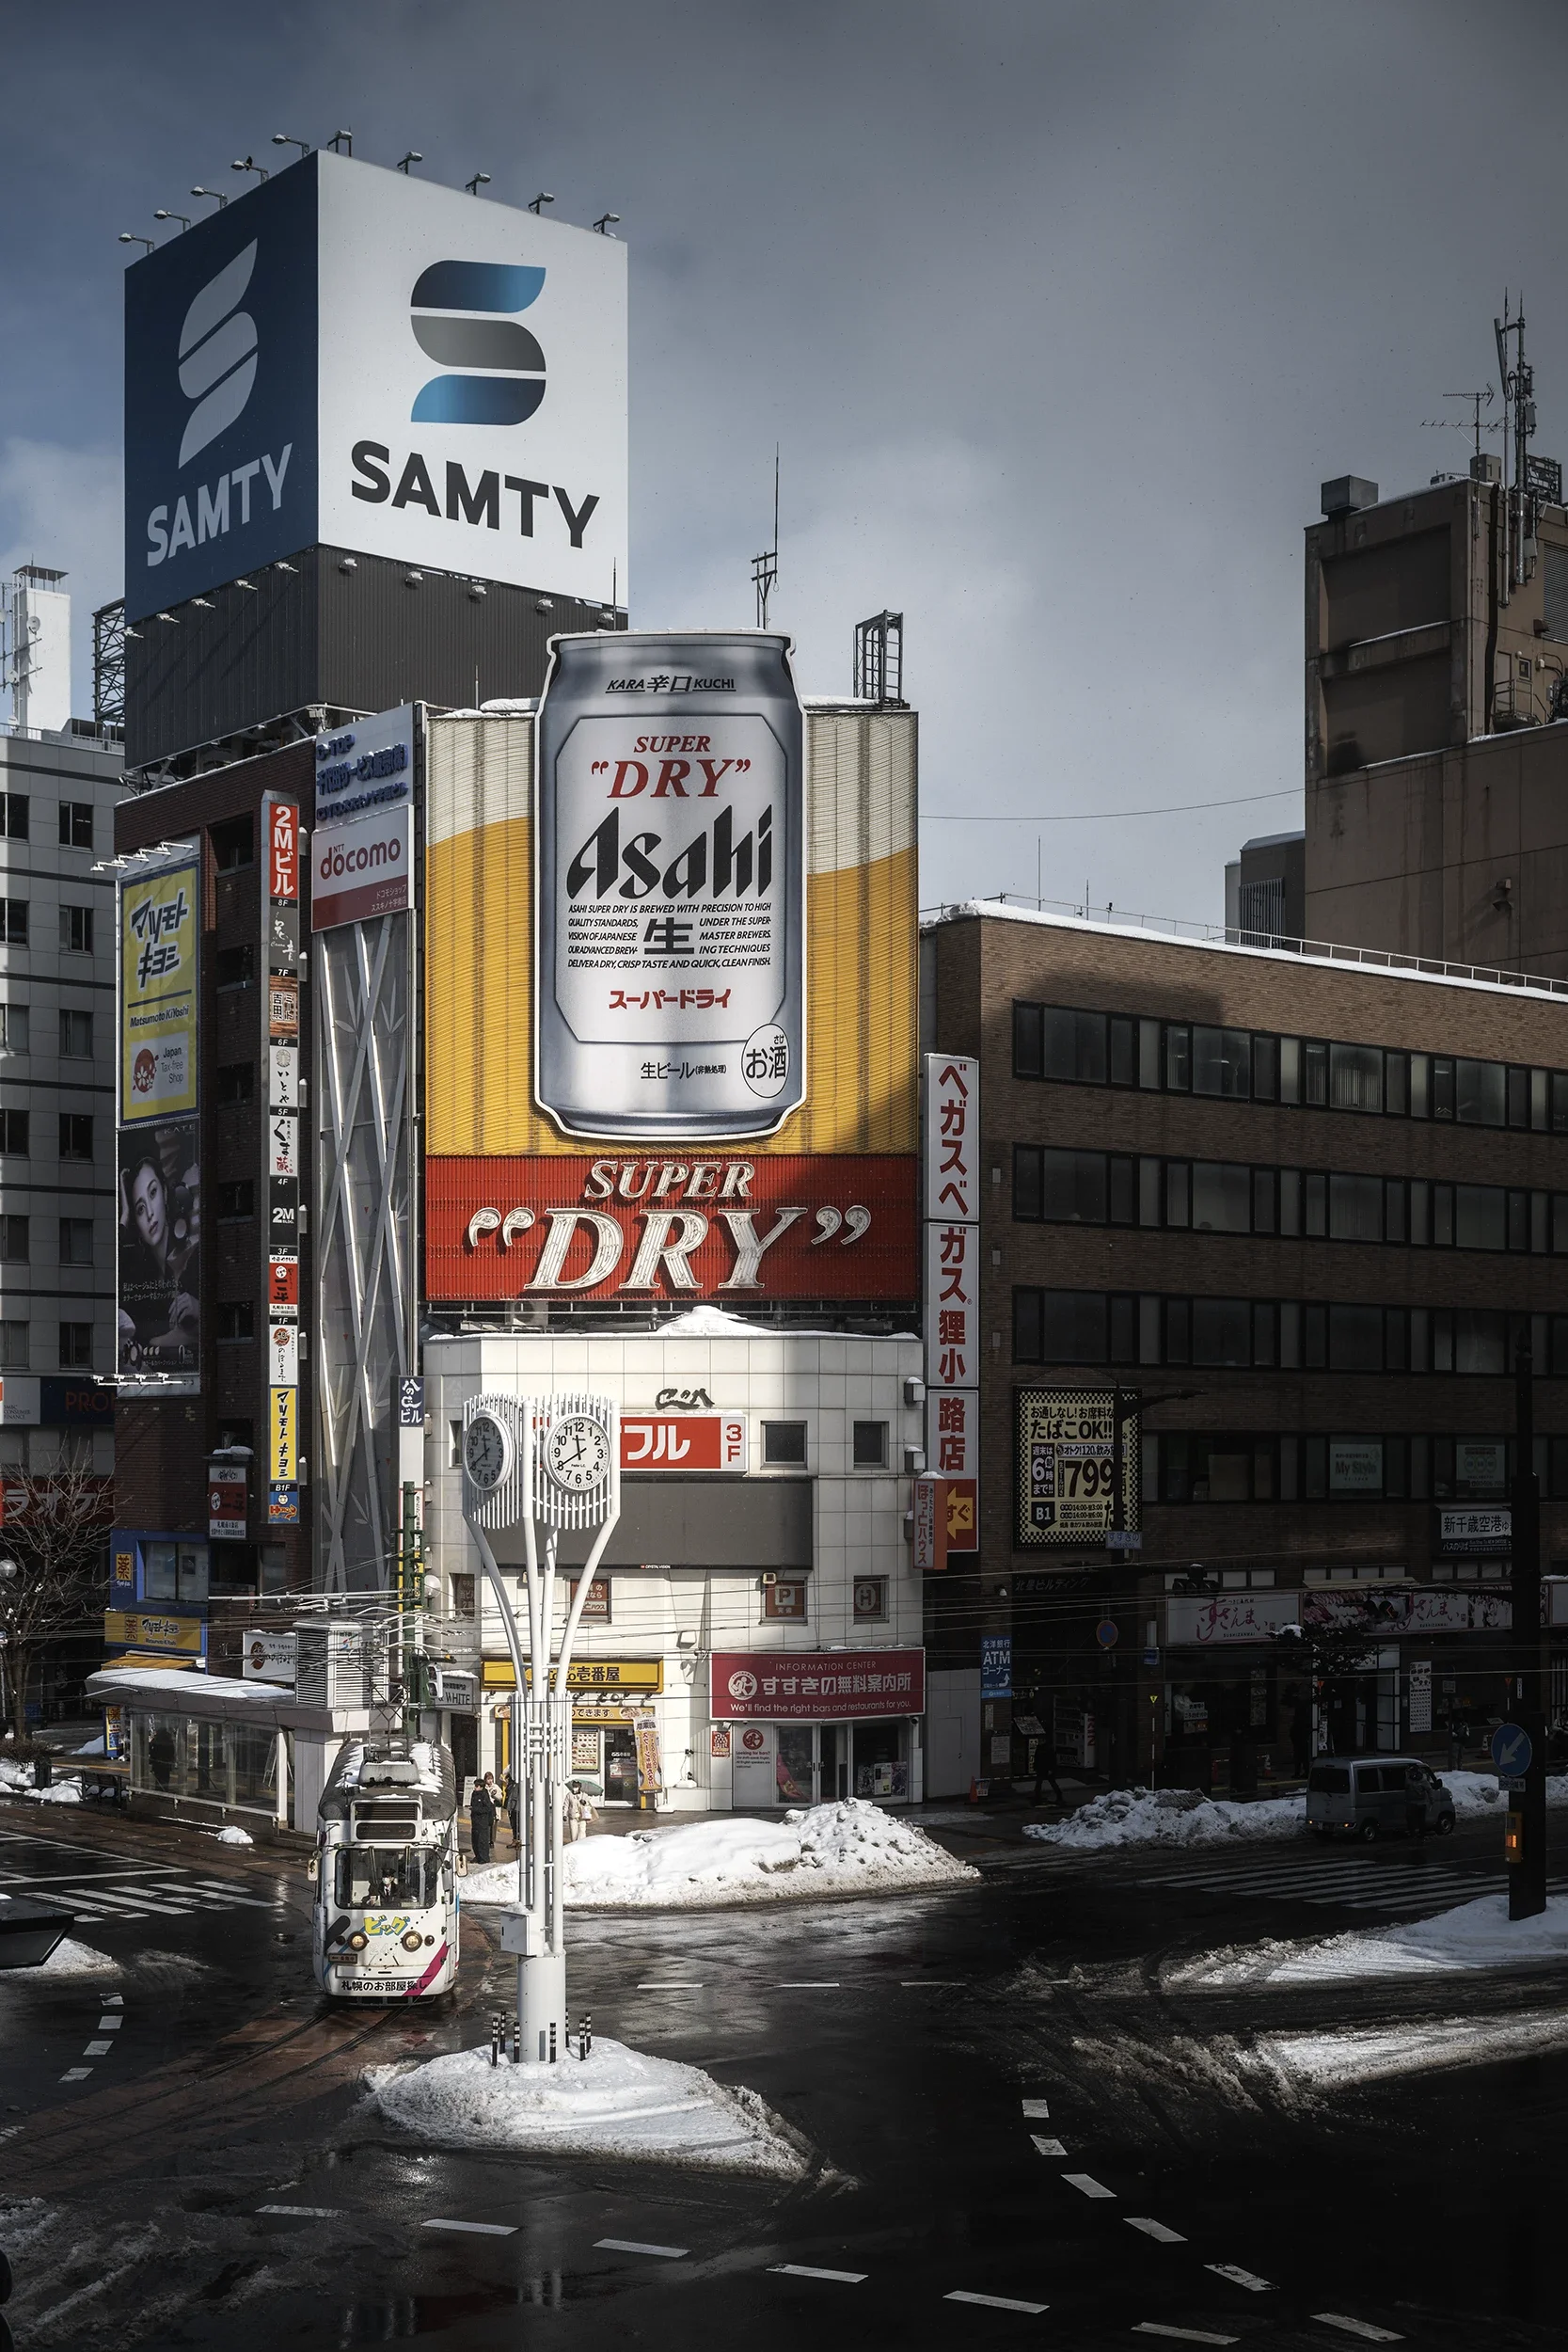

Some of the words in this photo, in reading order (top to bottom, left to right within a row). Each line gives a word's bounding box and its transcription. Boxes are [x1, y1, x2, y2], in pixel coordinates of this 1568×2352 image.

[351, 440, 600, 548] SAMTY
[147, 442, 293, 566] SAMTY
[608, 679, 644, 690] KARA
[647, 675, 692, 692] 辛口
[693, 678, 735, 690] KUCHI
[634, 736, 711, 753] SUPER
[274, 805, 294, 896] 2Mビル
[333, 843, 344, 853] NTT
[566, 804, 772, 900] Asahi
[321, 838, 401, 880] docomo
[376, 883, 407, 899] ドコモショップ
[568, 905, 587, 914] ASAHI
[588, 905, 610, 914] SUPER
[612, 905, 629, 914] DRY
[630, 905, 639, 914] IS
[639, 905, 674, 914] BREWED
[677, 904, 700, 913] WITH
[701, 903, 743, 913] PRECISION
[744, 903, 753, 912] TO
[754, 902, 771, 911] HIGH
[131, 892, 188, 943] マツモト
[568, 918, 594, 927] QUALITY
[594, 918, 639, 928] STANDARDS,
[699, 917, 730, 927] UNDER
[731, 916, 748, 926] THE
[568, 931, 589, 940] VISION
[597, 932, 638, 941] JAPANESE
[699, 930, 736, 940] MASTER
[643, 917, 694, 955] 生
[580, 946, 614, 954] ADVANCED
[699, 946, 717, 954] ING
[719, 944, 770, 953] TECHNIQUES
[137, 942, 180, 988] キヨシ
[617, 960, 641, 968] CRISP
[641, 960, 669, 968] TASTE
[669, 960, 689, 968] AND
[721, 958, 748, 967] CLEAN
[277, 968, 289, 977] 7F
[609, 988, 732, 1009] スーパードライ
[773, 1035, 784, 1044] さけ
[163, 1047, 182, 1059] Japan
[161, 1060, 183, 1073] Tax-free
[746, 1045, 787, 1080] お酒
[169, 1073, 183, 1084] Shop
[165, 1123, 195, 1135] KATE
[585, 1160, 755, 1199] SUPER
[401, 1409, 422, 1423] ビル
[277, 1391, 290, 1478] マツモトキヨシ
[1030, 1420, 1112, 1439] たばこOK!!
[726, 1423, 742, 1462] 3F
[1033, 1457, 1045, 1481] 6
[276, 1484, 291, 1492] B1F
[1036, 1507, 1051, 1520] B1
[1109, 1532, 1139, 1541] すすきの
[118, 1555, 130, 1579] 薬
[779, 1588, 791, 1603] P
[983, 1639, 1010, 1648] 北洋銀行
[983, 1651, 1010, 1664] ATM
[775, 1662, 844, 1672] INFORMATION
[847, 1661, 876, 1670] CENTER
[983, 1666, 1010, 1676] コーナー
[761, 1672, 911, 1695] すすきの無料案内所
[446, 1692, 470, 1705] WHITE
[730, 1704, 752, 1712] We'll
[753, 1704, 771, 1712] find
[773, 1704, 788, 1712] the
[790, 1704, 811, 1715] right
[813, 1704, 832, 1712] bars
[832, 1702, 847, 1711] and
[847, 1701, 885, 1710] restaurants
[886, 1700, 895, 1708] for
[896, 1700, 911, 1709] you.
[364, 1914, 410, 1936] ビッグ
[341, 1979, 429, 1993] 札幌のお部屋探し
